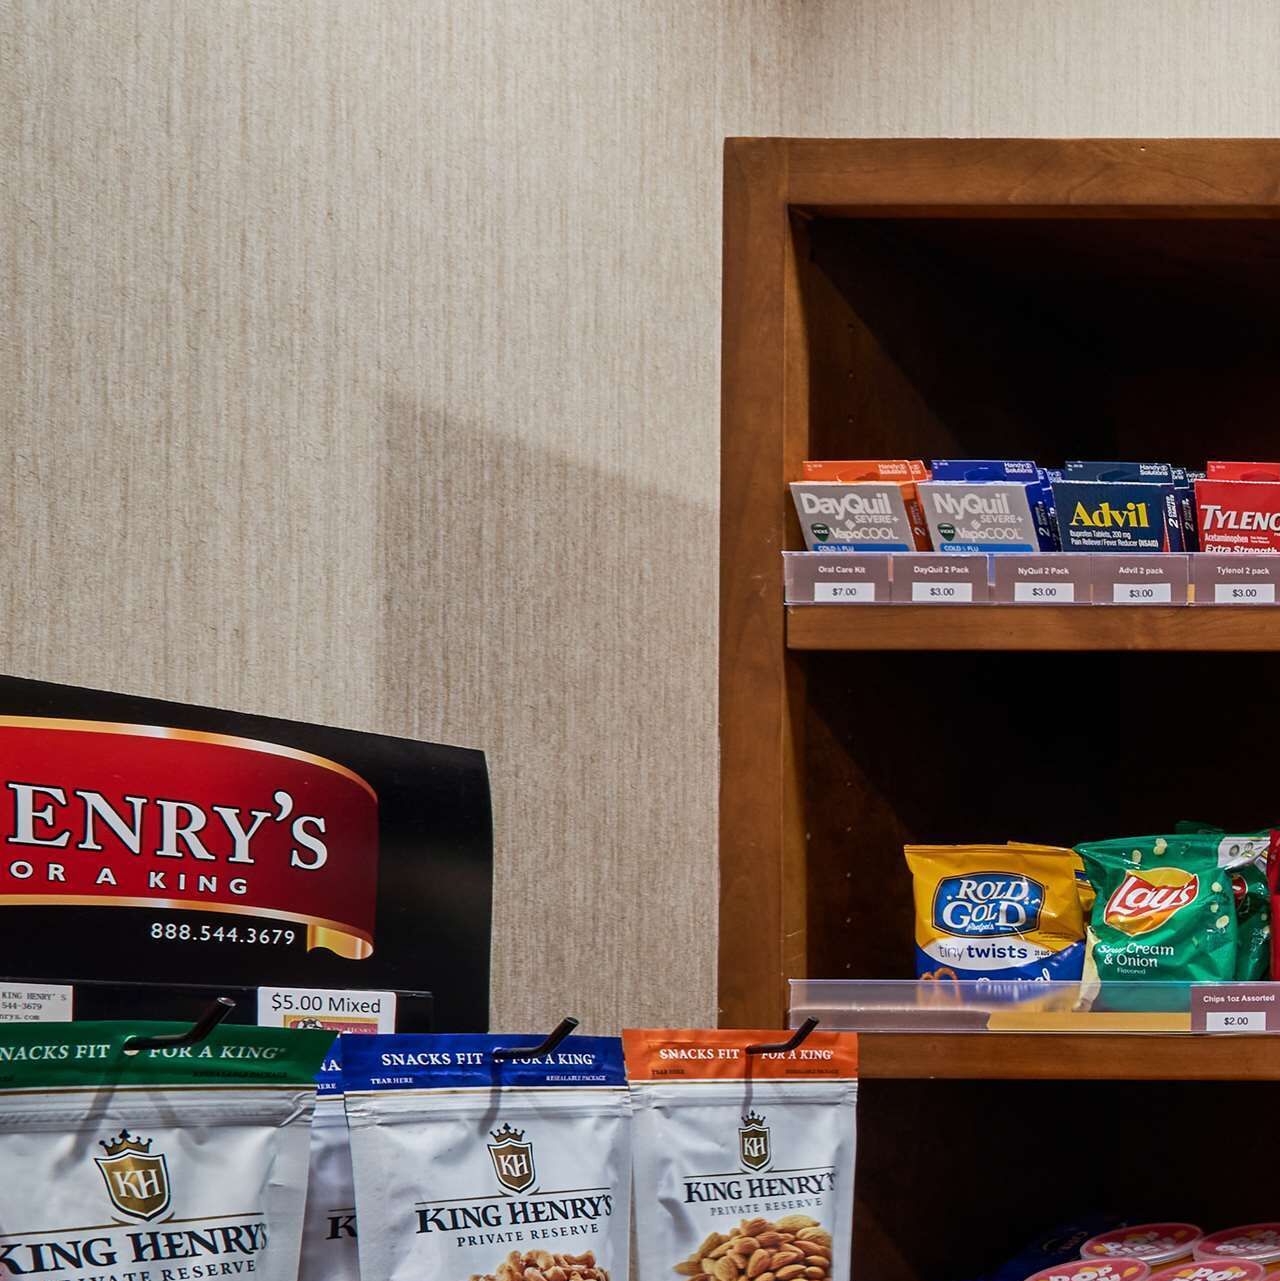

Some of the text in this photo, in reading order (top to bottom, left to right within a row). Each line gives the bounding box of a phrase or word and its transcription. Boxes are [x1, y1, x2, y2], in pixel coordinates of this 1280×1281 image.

[799, 493, 892, 520] DayQuil
[933, 493, 1010, 521] NyQuil
[1069, 501, 1150, 528] Advil
[818, 566, 833, 574] Oral
[831, 588, 857, 597] $7.00
[7, 782, 328, 870] ENRY'S
[9, 862, 248, 895] OR A KING
[958, 880, 1029, 901] ROLD
[1111, 877, 1197, 916] Lay's
[942, 902, 1027, 928] GOLD
[150, 922, 295, 946] 888.544.3679
[939, 944, 1028, 959] tiny twists
[271, 994, 381, 1014] $5.00 Mixed
[1203, 995, 1224, 1004] Chips
[1242, 994, 1275, 1002] Assorted
[1224, 1016, 1249, 1026] $2.00
[416, 1194, 614, 1235] KING HENRY'S
